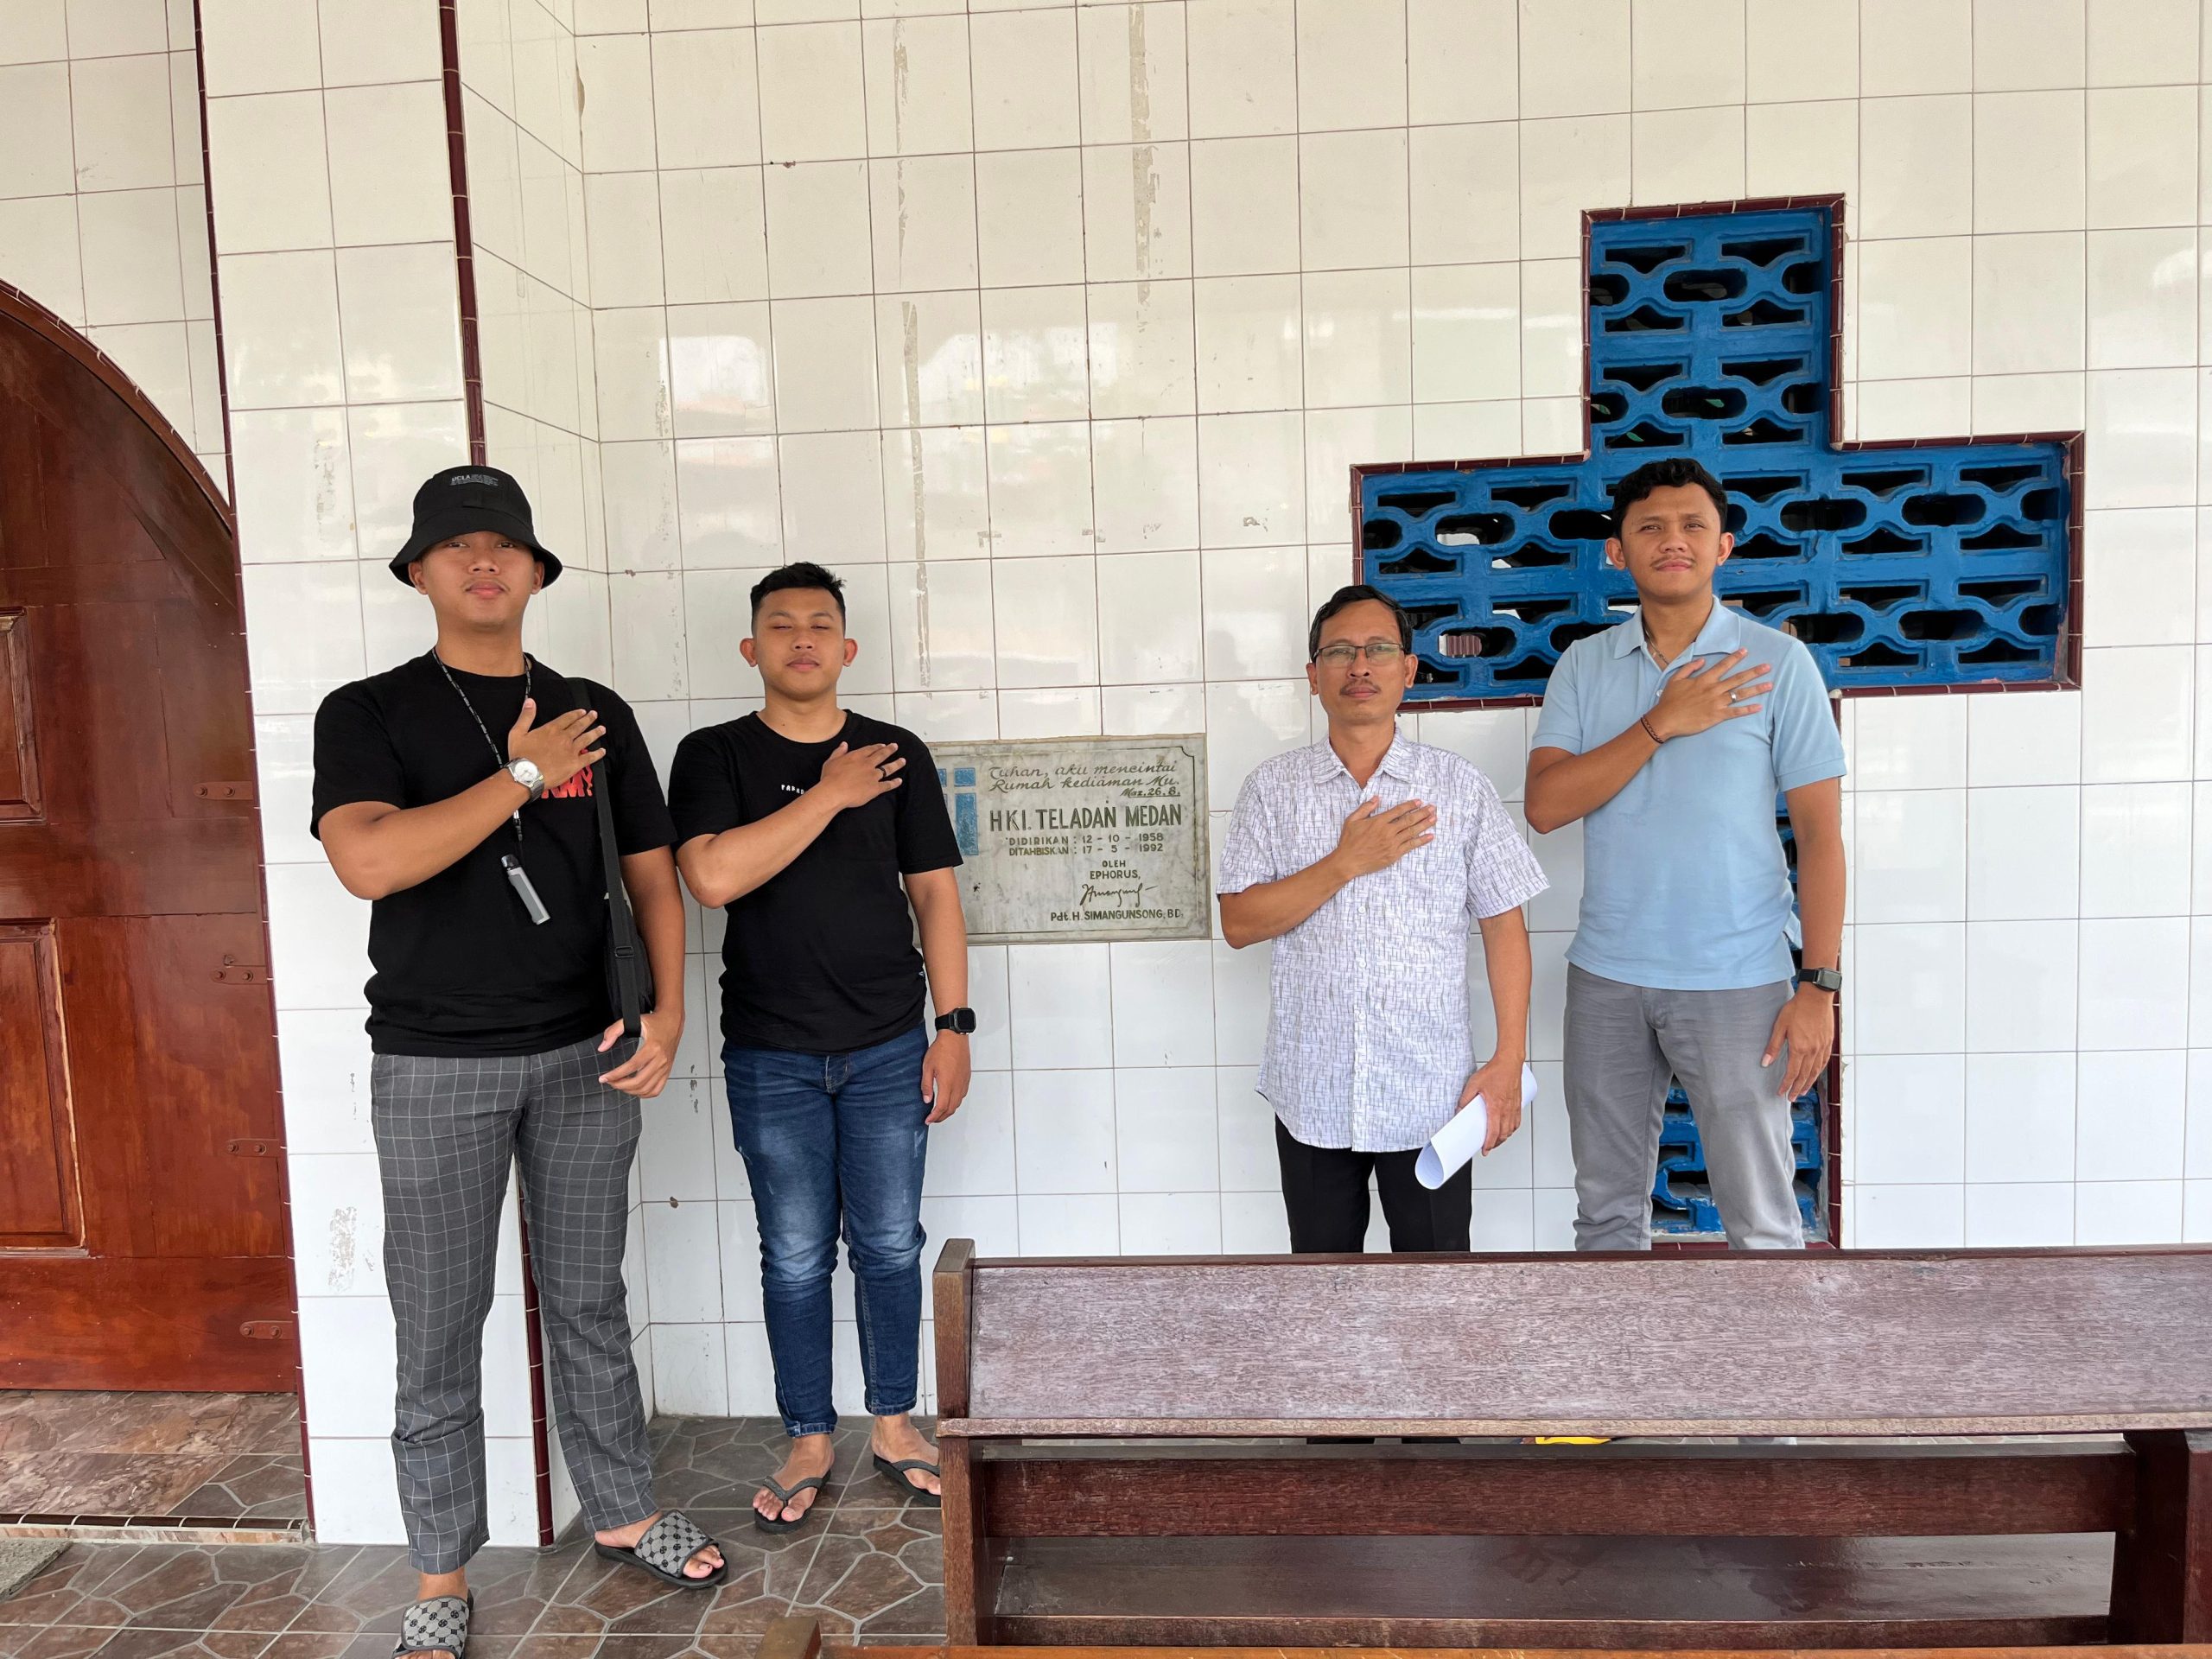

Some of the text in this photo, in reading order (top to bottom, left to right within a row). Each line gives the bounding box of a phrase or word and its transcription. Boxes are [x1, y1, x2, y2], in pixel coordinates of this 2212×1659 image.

[988, 766, 1049, 780] Tuhan,
[1054, 763, 1089, 776] aku
[988, 779, 1056, 794] Rumah
[1059, 776, 1143, 789] kediaman
[1036, 806, 1116, 830] TELADAN
[1125, 804, 1183, 827] MEDAN
[1009, 836, 1069, 846] DIDIRIKAN
[1082, 835, 1093, 844] 12
[1109, 834, 1120, 843] 10
[1139, 833, 1164, 842] 1958
[1009, 846, 1069, 856] DITAHBISKAN
[1082, 845, 1093, 855] 17
[1110, 845, 1118, 854] 5
[1139, 843, 1163, 852] 1992
[1090, 870, 1141, 880] EPHORUS,
